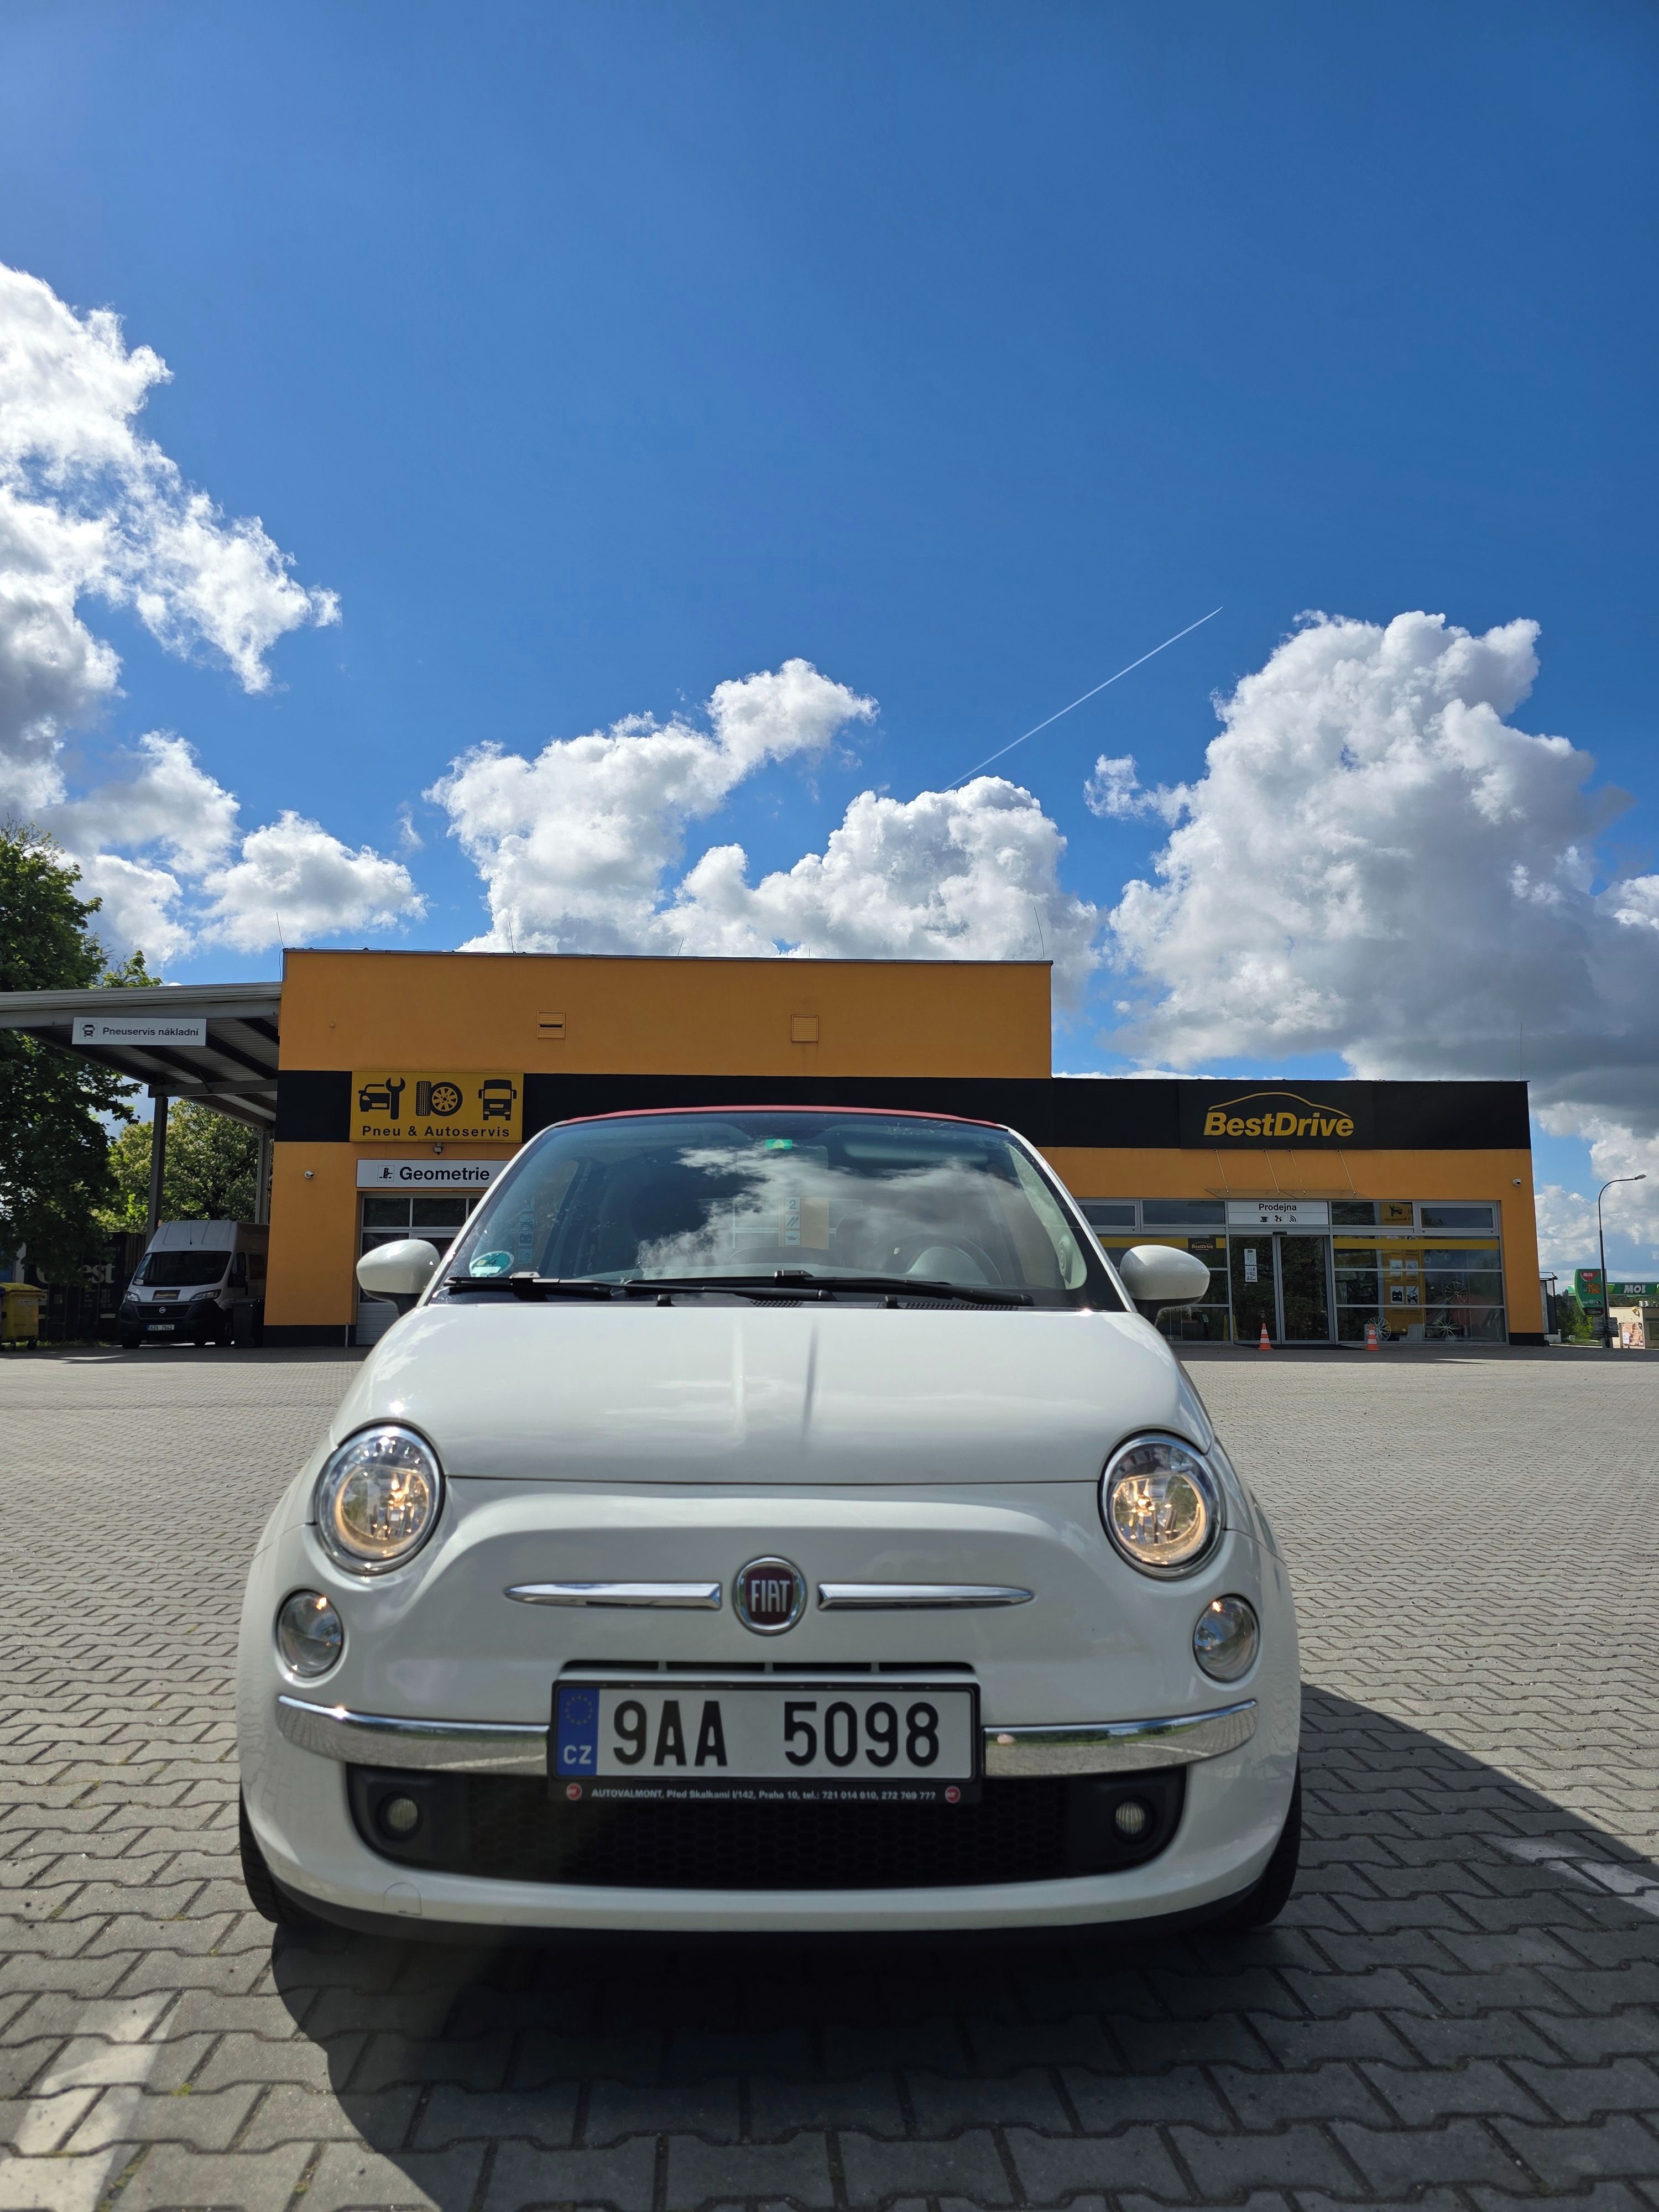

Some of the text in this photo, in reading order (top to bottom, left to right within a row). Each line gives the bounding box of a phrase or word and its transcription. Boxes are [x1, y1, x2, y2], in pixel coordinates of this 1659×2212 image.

[103, 1027, 199, 1036] Pneuservis nákladní
[1203, 1112, 1354, 1136] BestDrive
[362, 1125, 510, 1137] Pneu & Autoservis
[399, 1166, 490, 1181] Geometrie
[789, 1199, 797, 1209] 2
[1259, 1203, 1297, 1212] Prodejna
[1623, 1285, 1646, 1293] MOL
[751, 1580, 790, 1612] FIAT
[613, 1700, 939, 1767] 9AA 5098
[564, 1744, 592, 1765] CZ
[591, 1788, 664, 1798] AUTOVALMONT,
[666, 1789, 687, 1798] Před
[759, 1790, 784, 1799] Praha
[787, 1791, 801, 1800] 10,
[822, 1791, 838, 1799] 721
[881, 1791, 898, 1800] 272
[920, 1791, 936, 1800] 777
